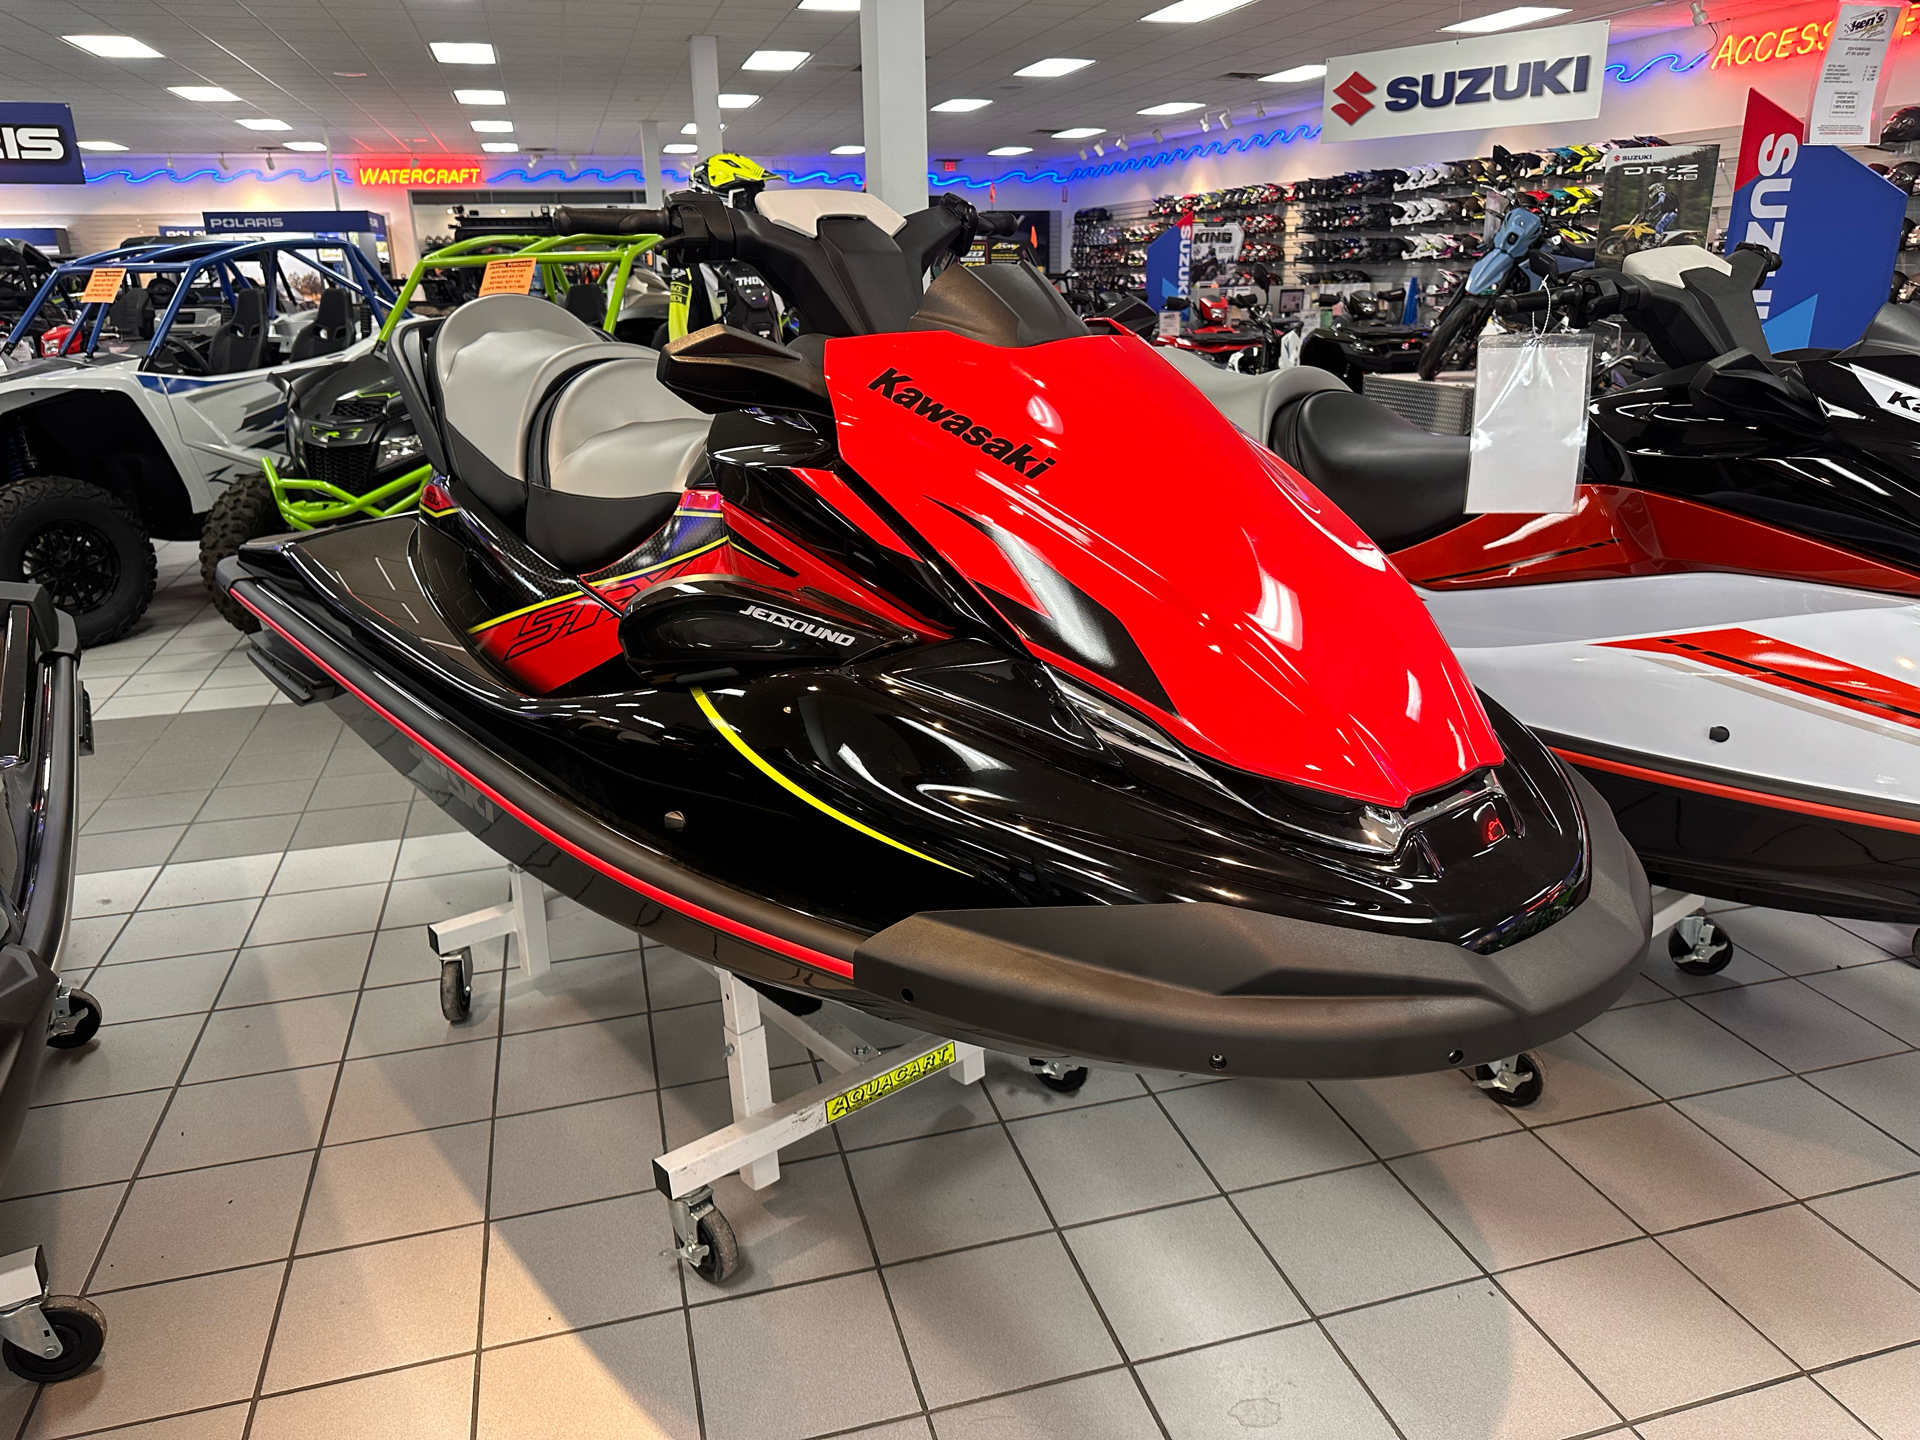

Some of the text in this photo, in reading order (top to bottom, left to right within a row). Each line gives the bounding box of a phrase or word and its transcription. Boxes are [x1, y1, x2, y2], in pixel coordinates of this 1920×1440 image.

[1384, 54, 1591, 112] SUZUKI
[0, 127, 65, 160] IS
[360, 167, 480, 185] WATERCRAFT
[1622, 163, 1699, 176] DR-Z
[210, 217, 284, 228] POLARIS
[1193, 231, 1232, 244] KING
[867, 367, 1057, 480] Kawasaki
[739, 604, 856, 647] JETSOUND
[832, 1046, 949, 1116] AQUACART
